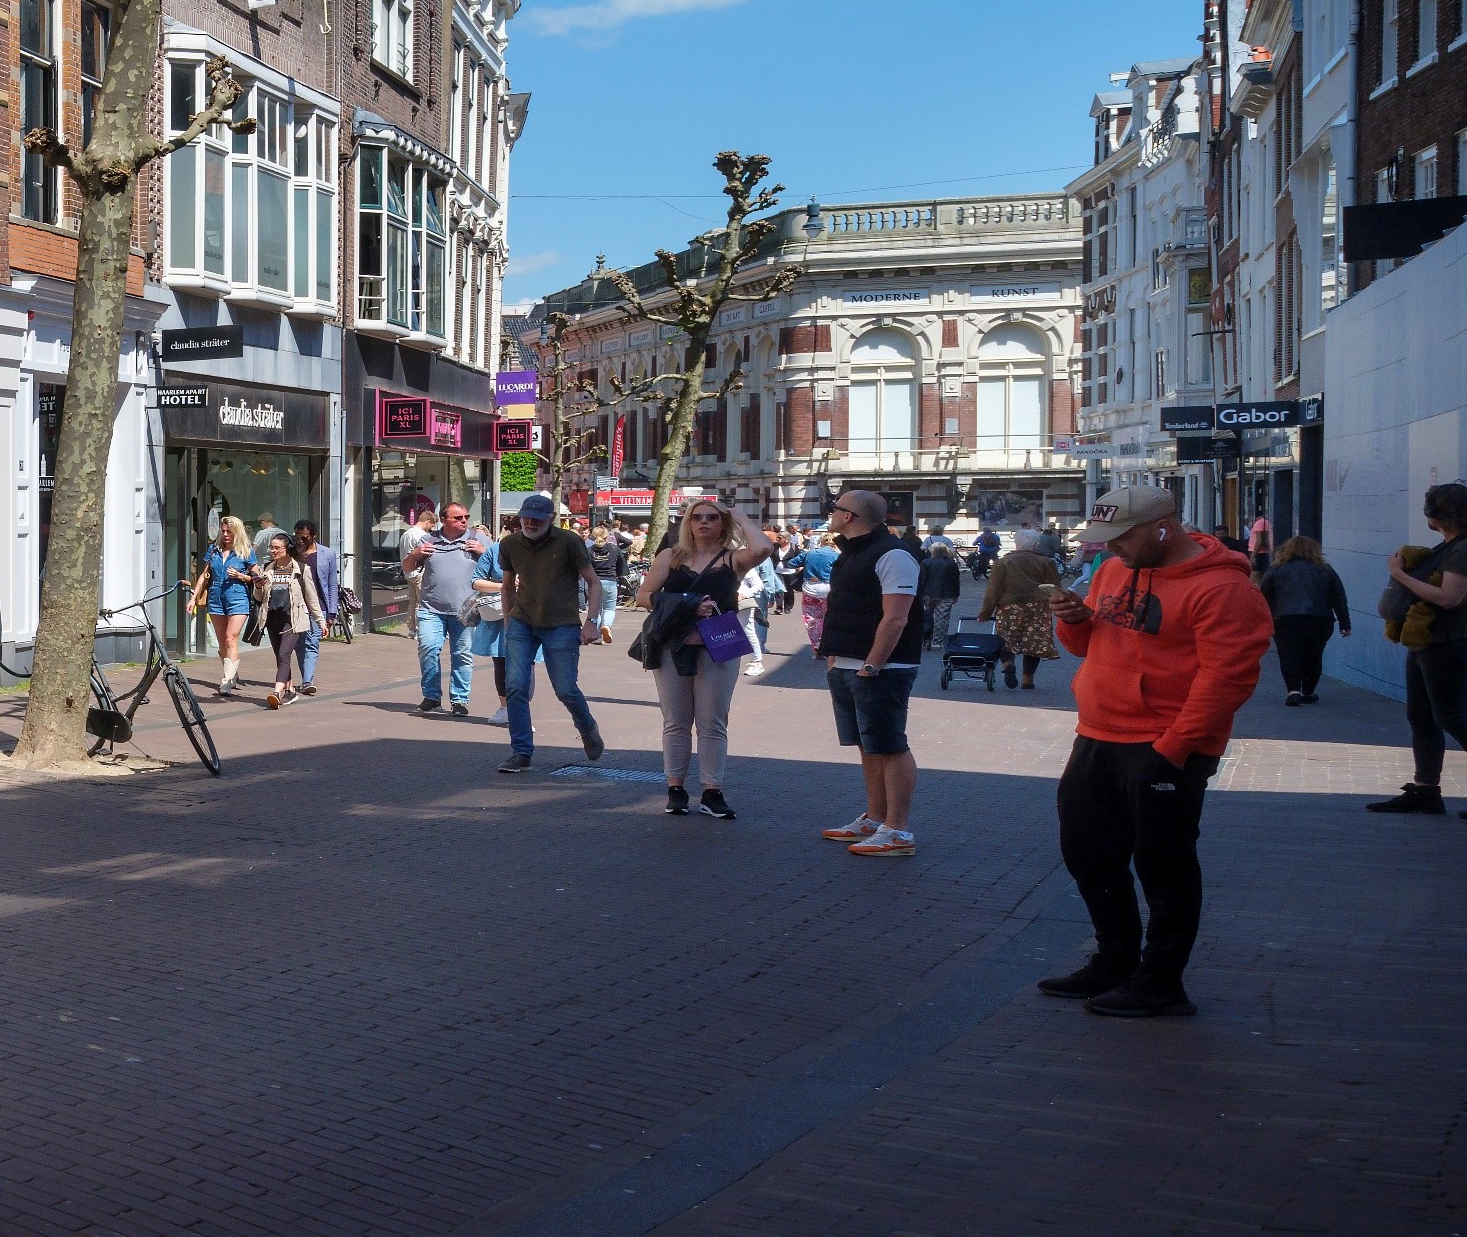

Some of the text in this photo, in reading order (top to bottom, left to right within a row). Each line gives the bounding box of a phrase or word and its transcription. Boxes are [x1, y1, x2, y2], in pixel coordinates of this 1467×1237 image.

[851, 292, 921, 303] MODERNE
[991, 287, 1039, 298] KUNST
[170, 337, 230, 350] claudia sträter
[498, 382, 534, 391] LUCARDI
[161, 395, 202, 405] HOTEL
[220, 396, 284, 429] claudia sträter
[398, 407, 413, 415] ICI
[1219, 408, 1290, 424] Gabor
[391, 414, 420, 422] PARIS
[1164, 422, 1199, 430] Timberland
[619, 496, 653, 505] VIETNAM
